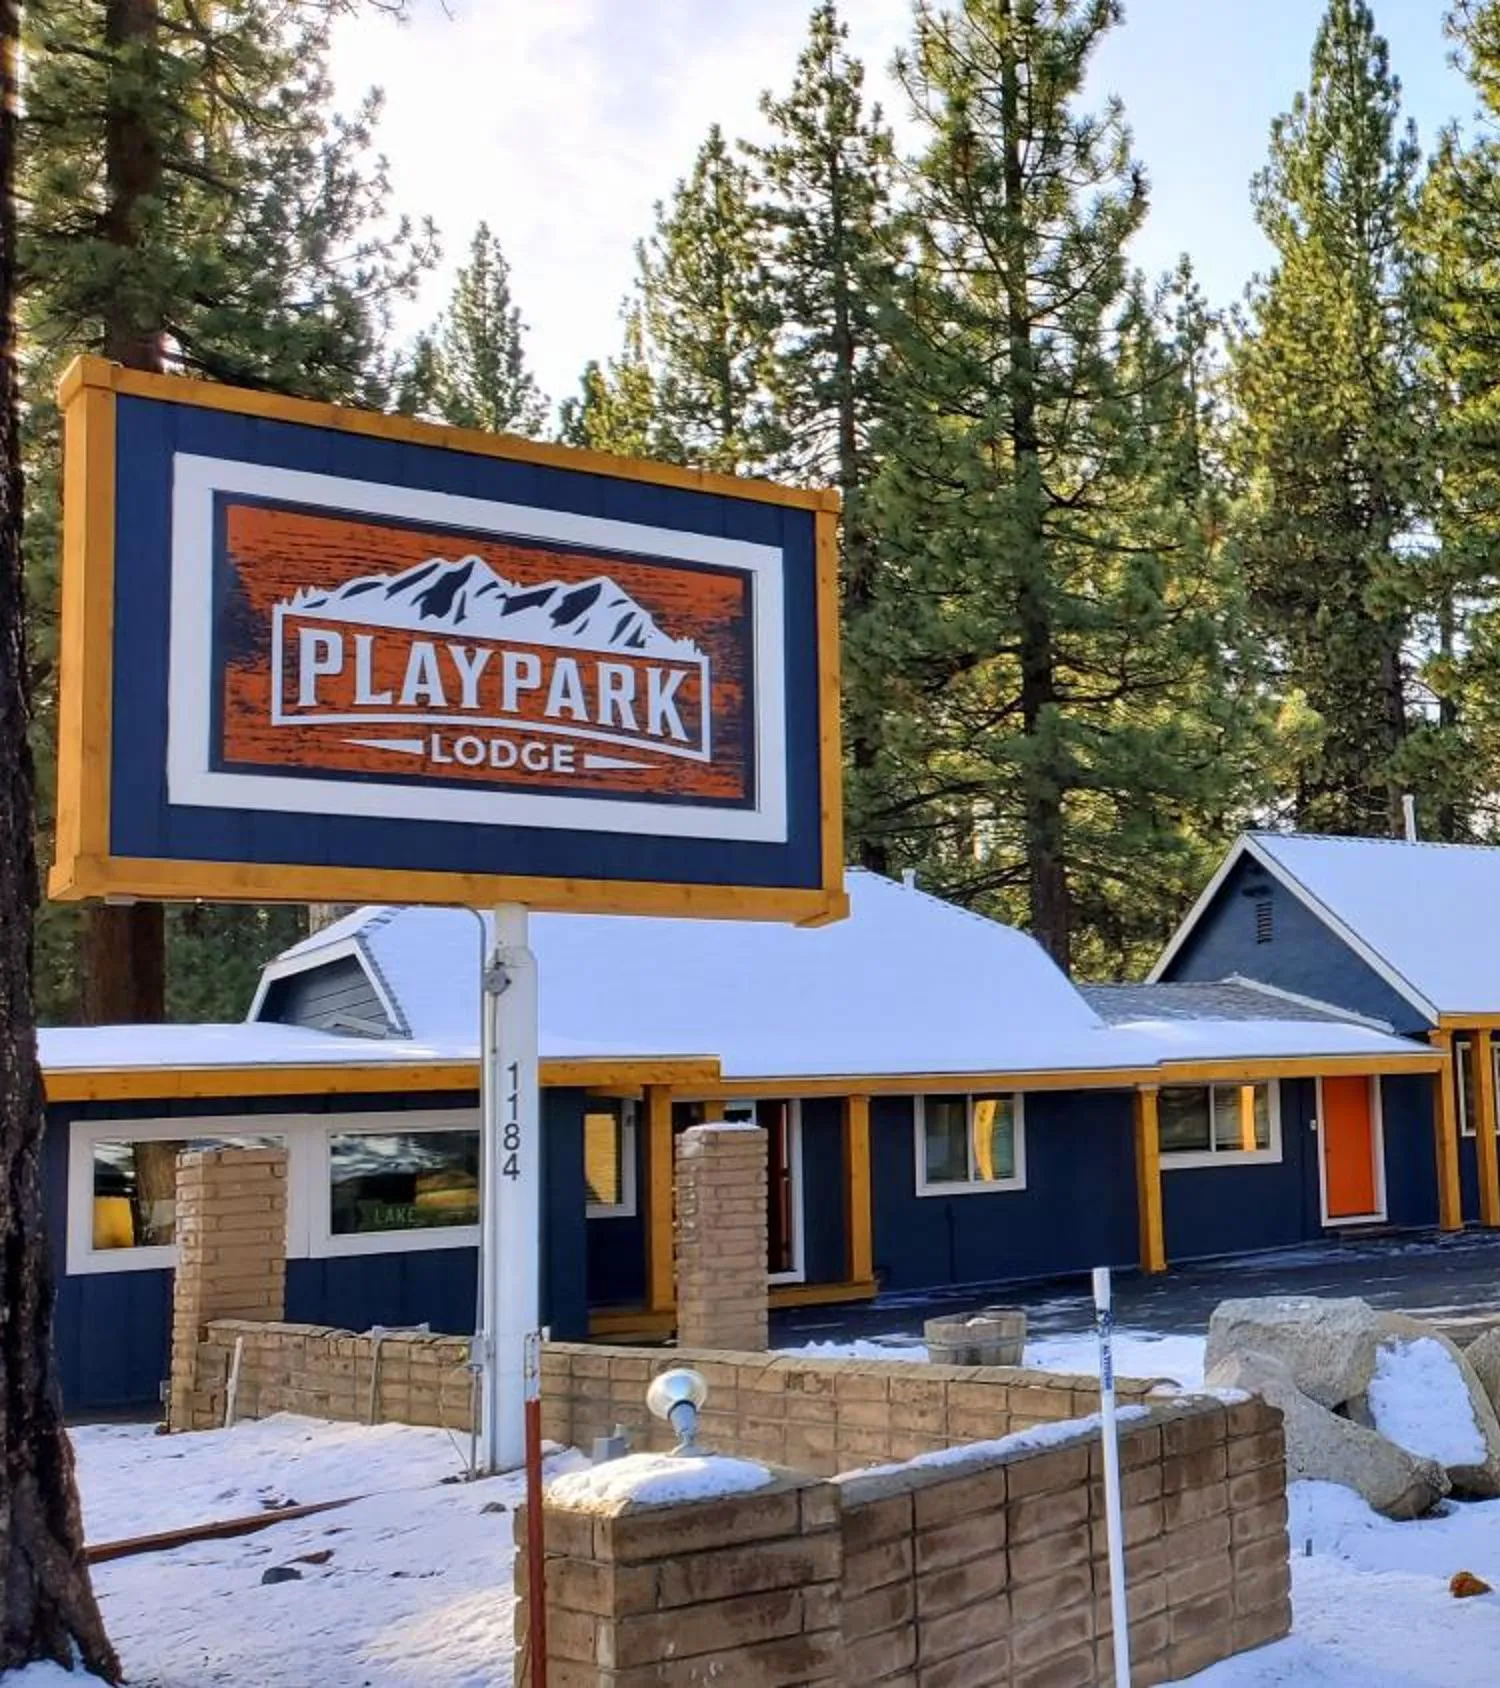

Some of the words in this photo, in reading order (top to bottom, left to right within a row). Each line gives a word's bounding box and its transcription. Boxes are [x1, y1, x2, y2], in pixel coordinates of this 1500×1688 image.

[298, 628, 689, 742] PLAYPARK
[431, 733, 575, 773] LODGE
[502, 1061, 520, 1181] 1184
[374, 1206, 416, 1225] LAKE
